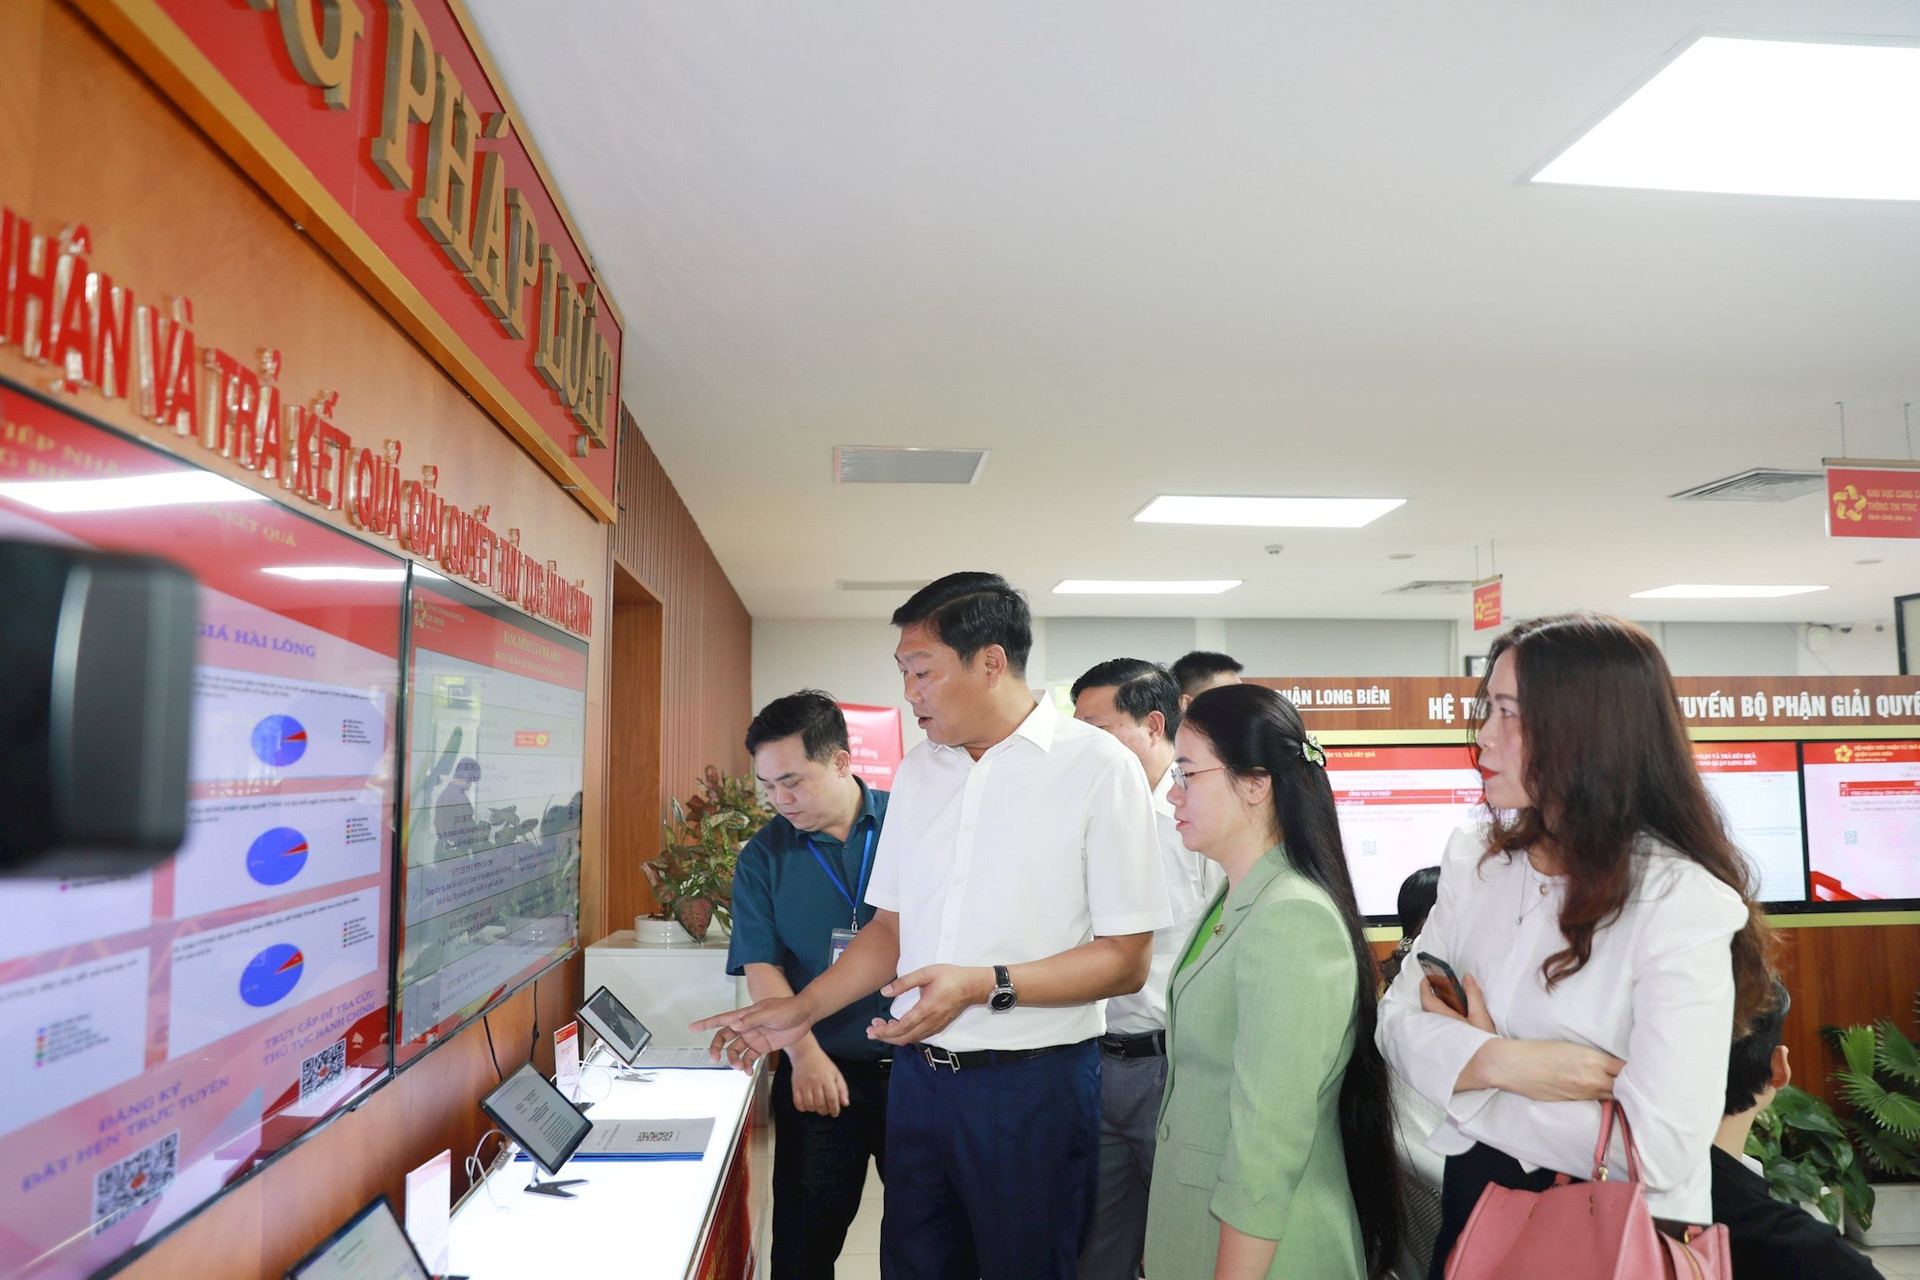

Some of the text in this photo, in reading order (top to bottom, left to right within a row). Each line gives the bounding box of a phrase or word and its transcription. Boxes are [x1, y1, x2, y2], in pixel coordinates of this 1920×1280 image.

[372, 0, 614, 458] PHÁP LUẬT
[137, 296, 199, 438] VÀ
[204, 347, 281, 480] TRẢ
[287, 391, 351, 511] KẾT
[349, 440, 402, 541] QUẢ
[402, 465, 444, 562] GIẢI
[444, 505, 497, 587] QUYẾT
[1316, 689, 1353, 705] LONG
[1357, 685, 1390, 705] BIÊN
[1428, 693, 1455, 724] HỆ
[1741, 691, 1768, 721] BỘ
[1773, 691, 1827, 720] PHẬN
[1831, 688, 1871, 717] GIẢI
